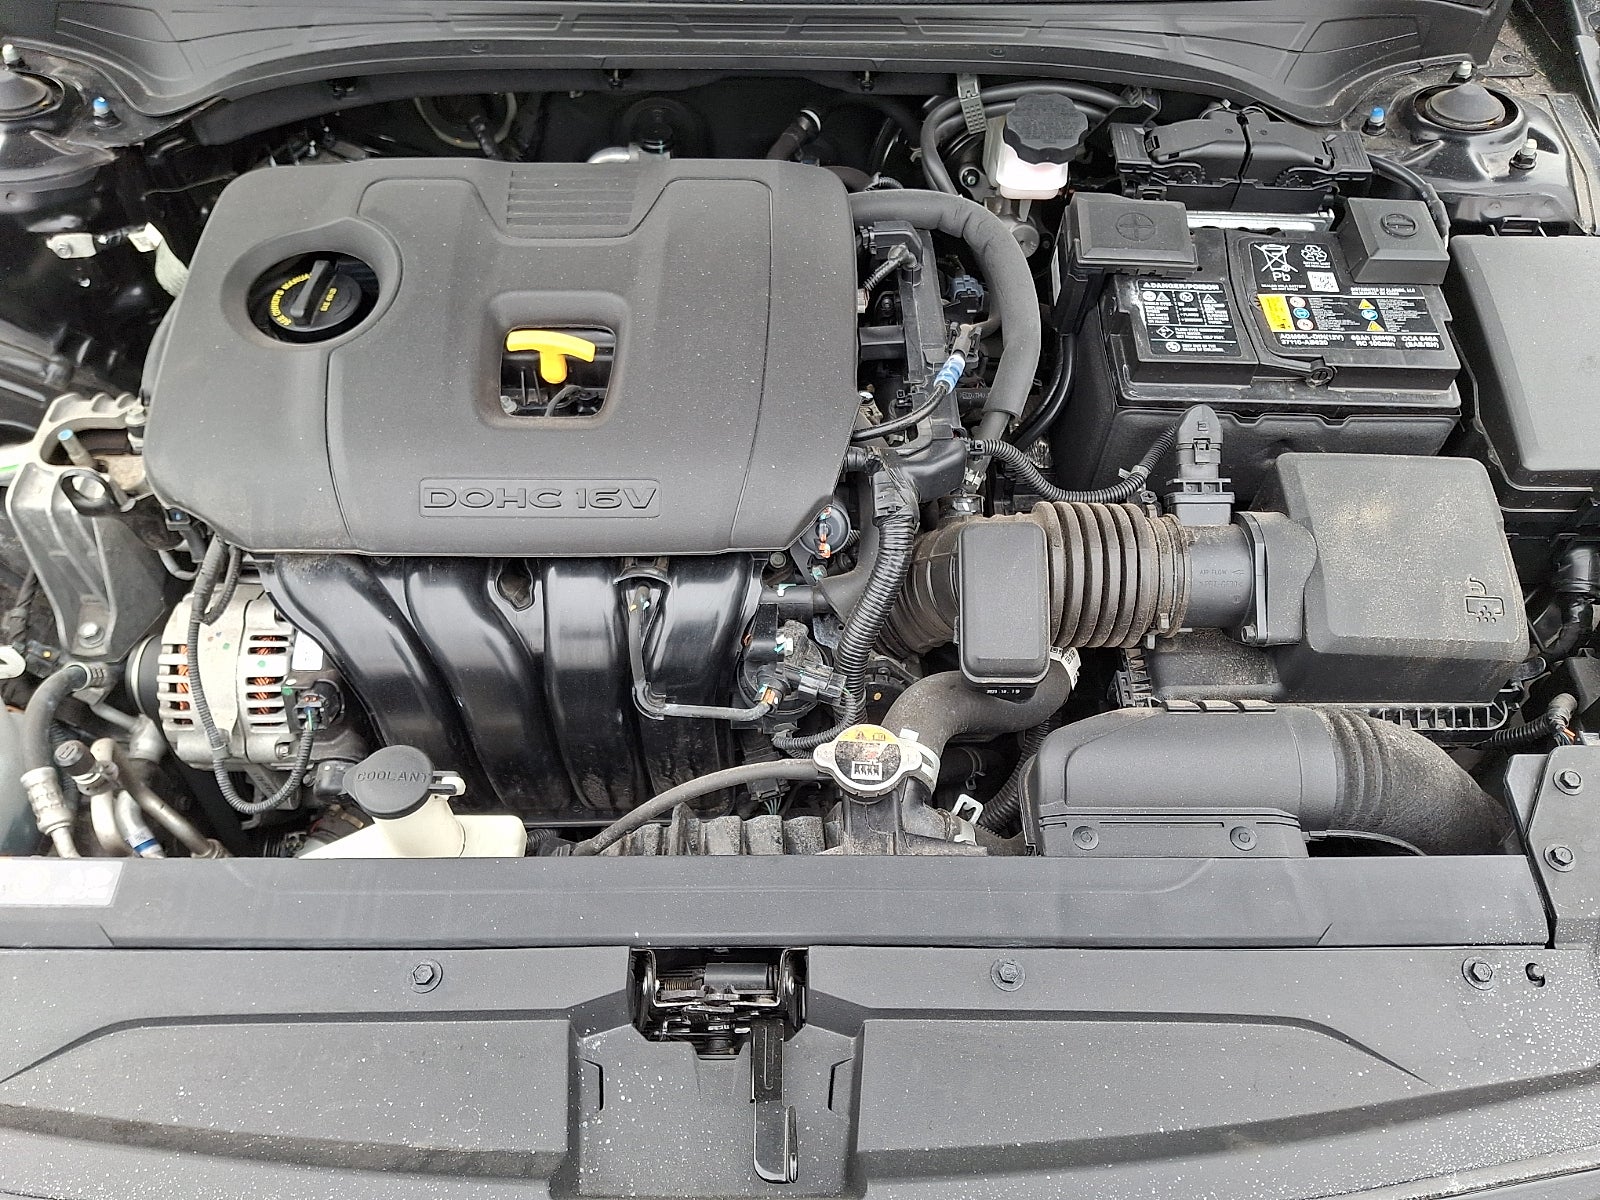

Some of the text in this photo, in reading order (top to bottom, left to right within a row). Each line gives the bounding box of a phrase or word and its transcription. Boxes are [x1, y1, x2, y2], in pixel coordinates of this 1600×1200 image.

[1272, 271, 1291, 281] Pb
[423, 487, 657, 509] DOHC 16V
[357, 769, 431, 784] COOLANT
